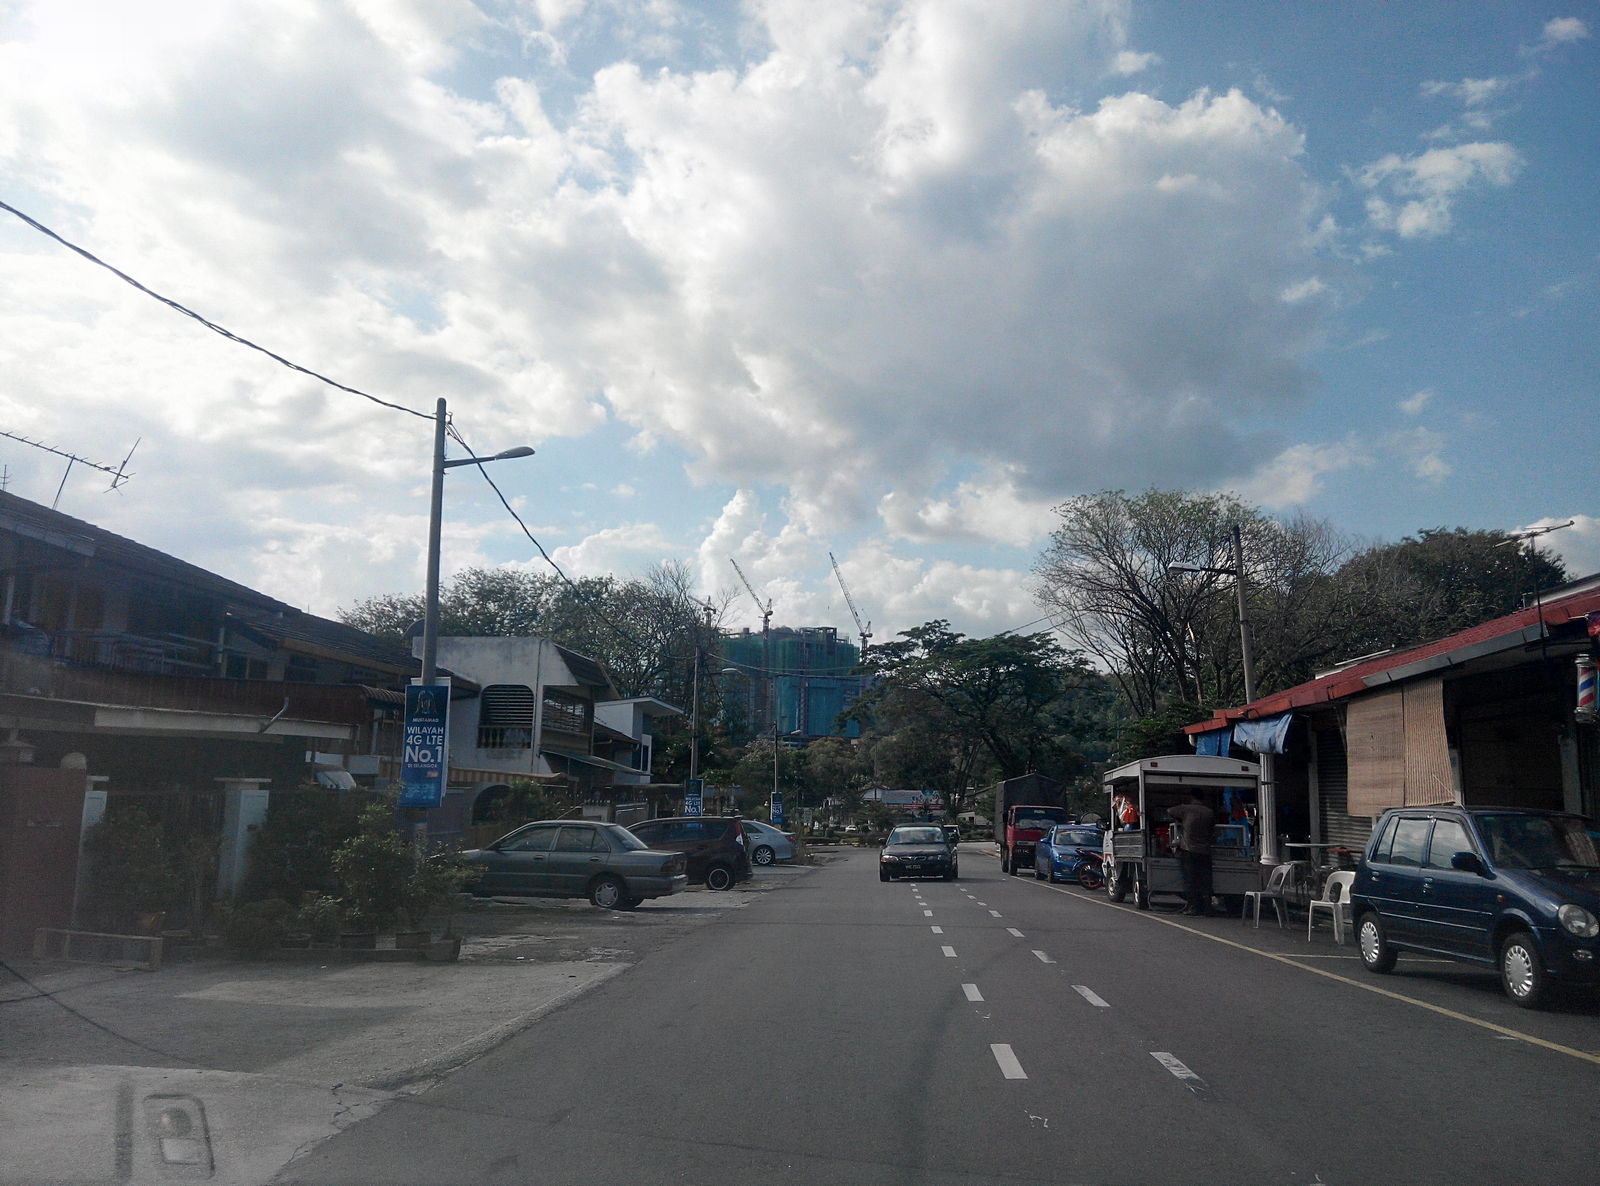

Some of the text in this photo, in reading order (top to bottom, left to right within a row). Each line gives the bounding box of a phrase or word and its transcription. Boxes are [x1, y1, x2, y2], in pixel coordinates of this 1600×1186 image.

[407, 726, 444, 734] WILAYAH
[407, 735, 443, 745] 4G LTE
[405, 745, 443, 763] No.1
